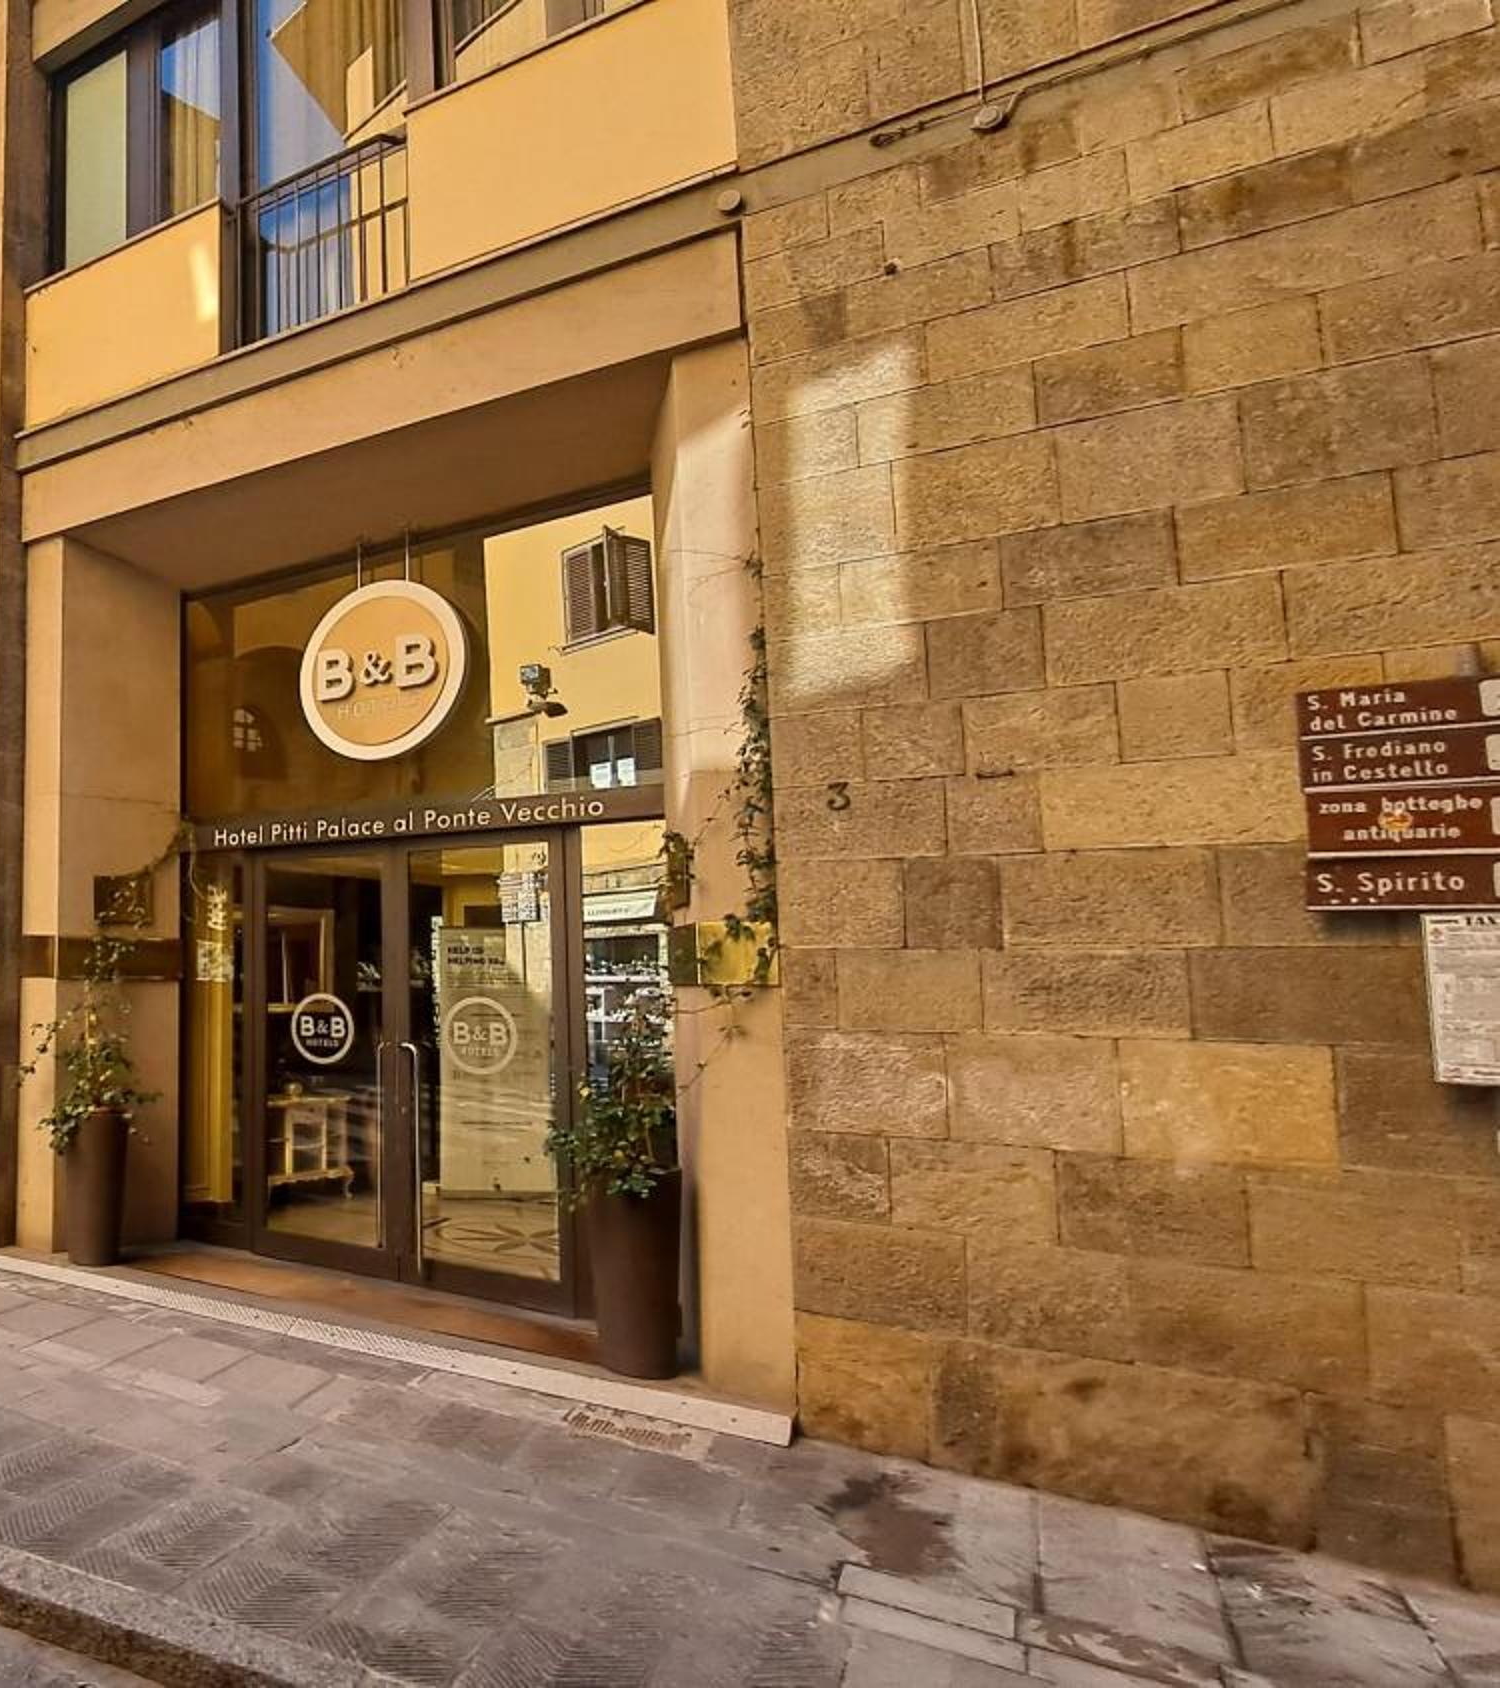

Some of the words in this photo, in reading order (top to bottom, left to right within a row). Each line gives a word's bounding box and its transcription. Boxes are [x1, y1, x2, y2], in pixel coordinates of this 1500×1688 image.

[315, 633, 438, 702] B&B
[1307, 695, 1329, 711] S.
[1340, 688, 1407, 707] Maria
[1309, 714, 1347, 731] del
[1357, 707, 1458, 727] Carmine
[1312, 746, 1333, 761] S.
[1343, 740, 1447, 760] Frediano
[1312, 768, 1333, 783] in
[1343, 761, 1449, 781] Cestello
[1319, 802, 1367, 814] zona
[1381, 793, 1483, 814] botteghe
[214, 824, 264, 847] Hotel
[271, 822, 308, 842] Pitti
[317, 818, 385, 839] Palace
[393, 810, 414, 833] al
[424, 808, 491, 830] Ponte
[500, 796, 605, 824] Vecchio
[1343, 824, 1462, 843] antiquarie
[1316, 873, 1344, 893] S.
[1357, 871, 1466, 896] Spirito
[300, 1015, 346, 1039] B&B
[453, 1021, 508, 1045] B&B
